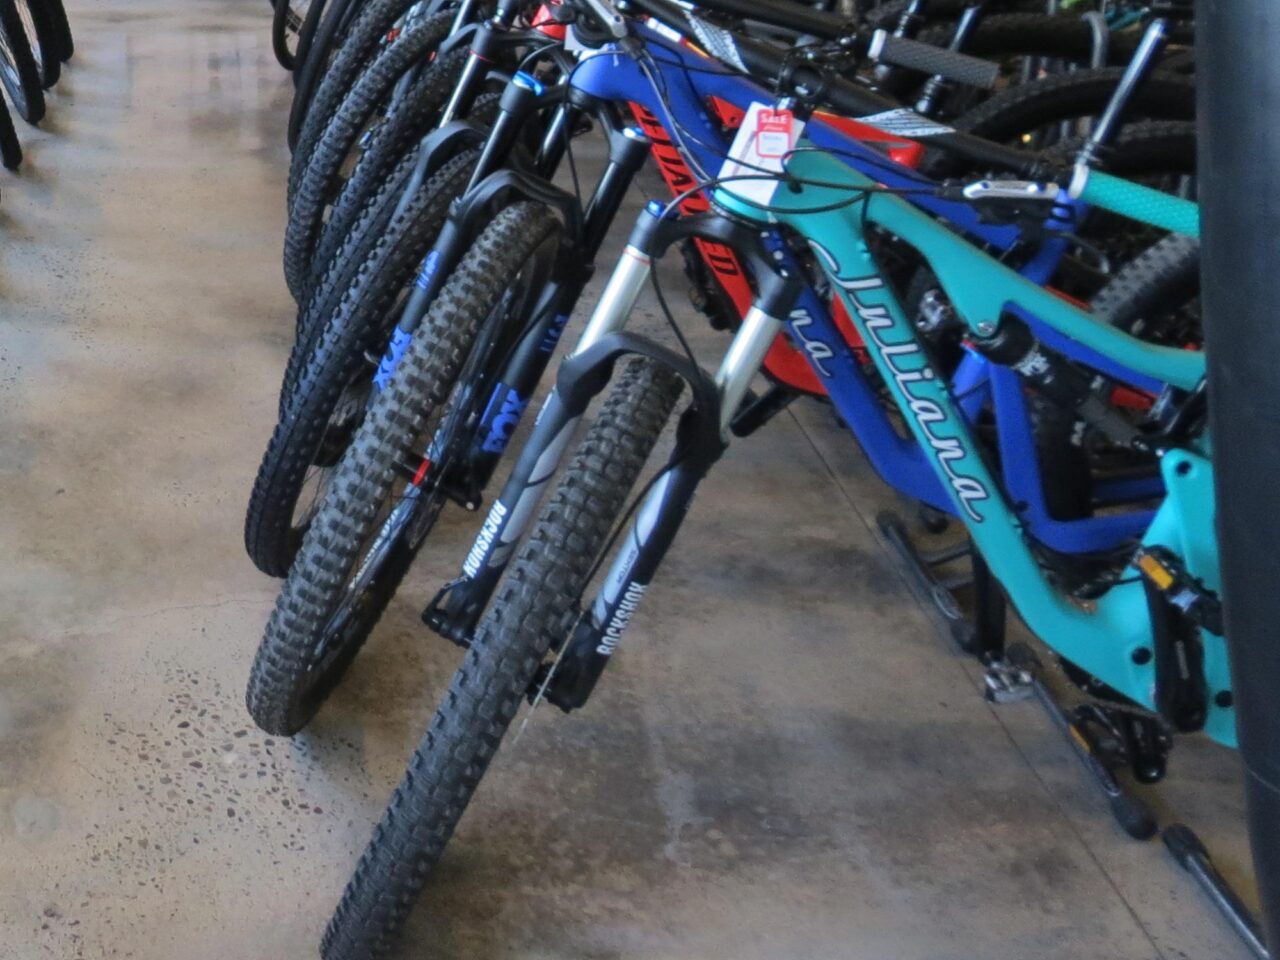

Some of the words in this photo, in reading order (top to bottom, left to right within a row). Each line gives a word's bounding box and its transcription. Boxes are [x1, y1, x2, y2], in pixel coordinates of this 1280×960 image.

[372, 326, 413, 391] FOX
[807, 238, 989, 523] Juliana
[482, 388, 531, 453] FOX
